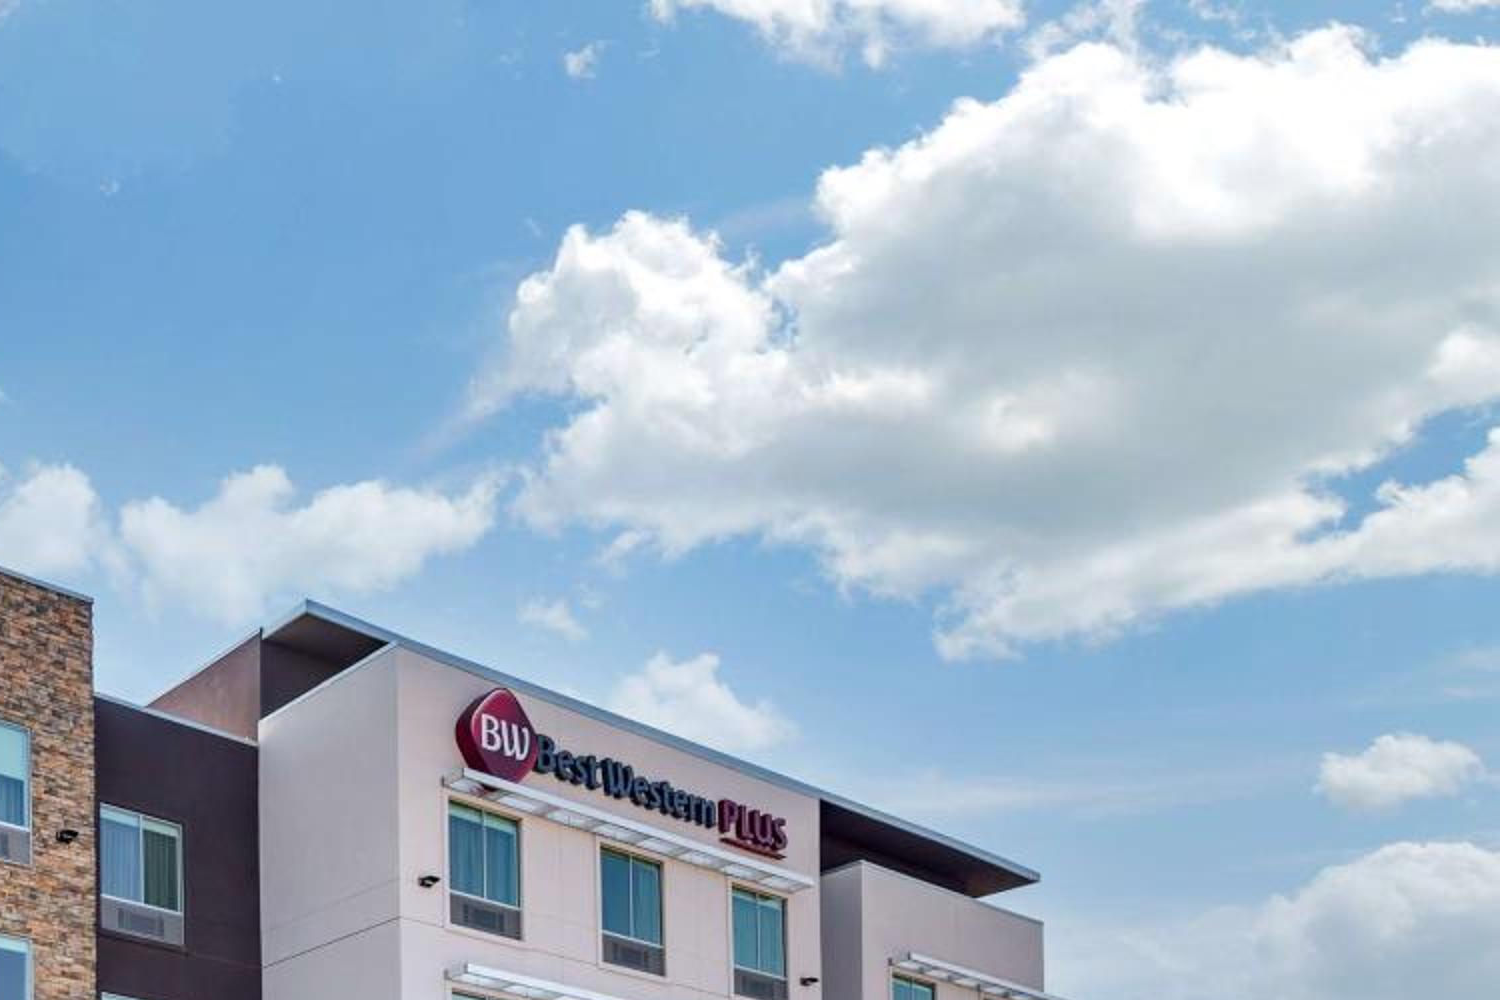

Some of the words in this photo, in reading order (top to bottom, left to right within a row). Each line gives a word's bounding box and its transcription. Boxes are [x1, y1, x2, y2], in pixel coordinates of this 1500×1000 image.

[481, 714, 530, 760] BW
[537, 734, 601, 790] Best
[602, 759, 717, 829] Western
[718, 799, 788, 851] PLUS
